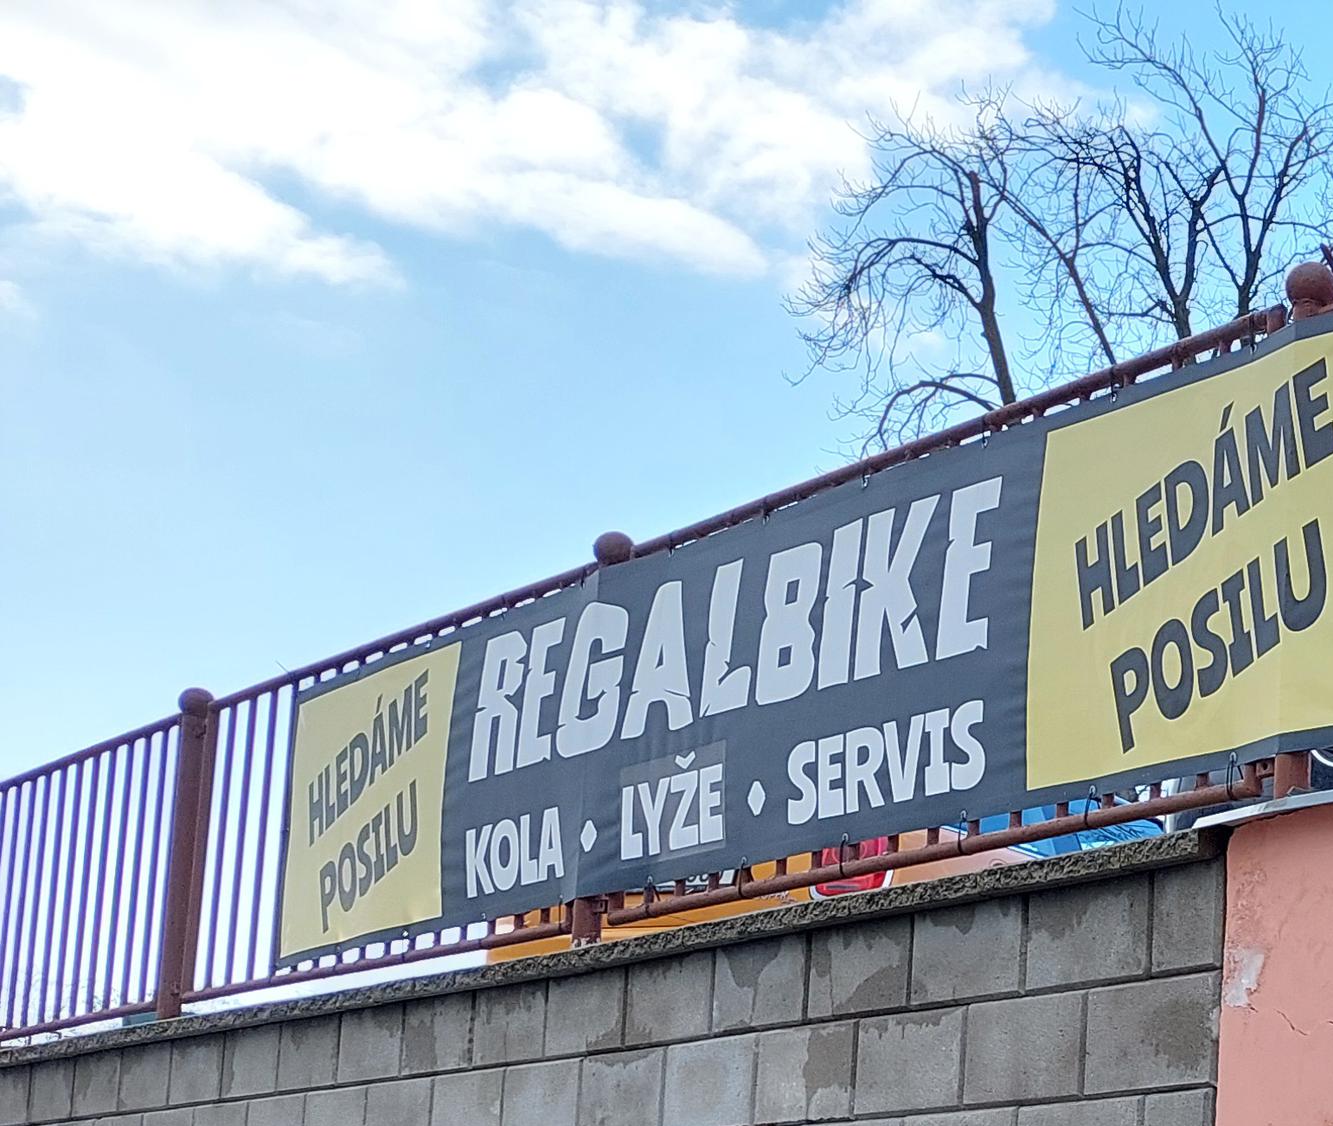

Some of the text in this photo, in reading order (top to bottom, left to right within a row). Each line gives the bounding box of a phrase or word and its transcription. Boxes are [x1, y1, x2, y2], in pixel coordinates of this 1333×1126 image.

[467, 475, 1004, 783] REGALBIKE
[1109, 519, 1328, 752] POSILU
[307, 671, 430, 846] HLEDÁME
[318, 778, 420, 932] POSILU
[464, 701, 987, 898] KOLA LYŽE SERVIS
